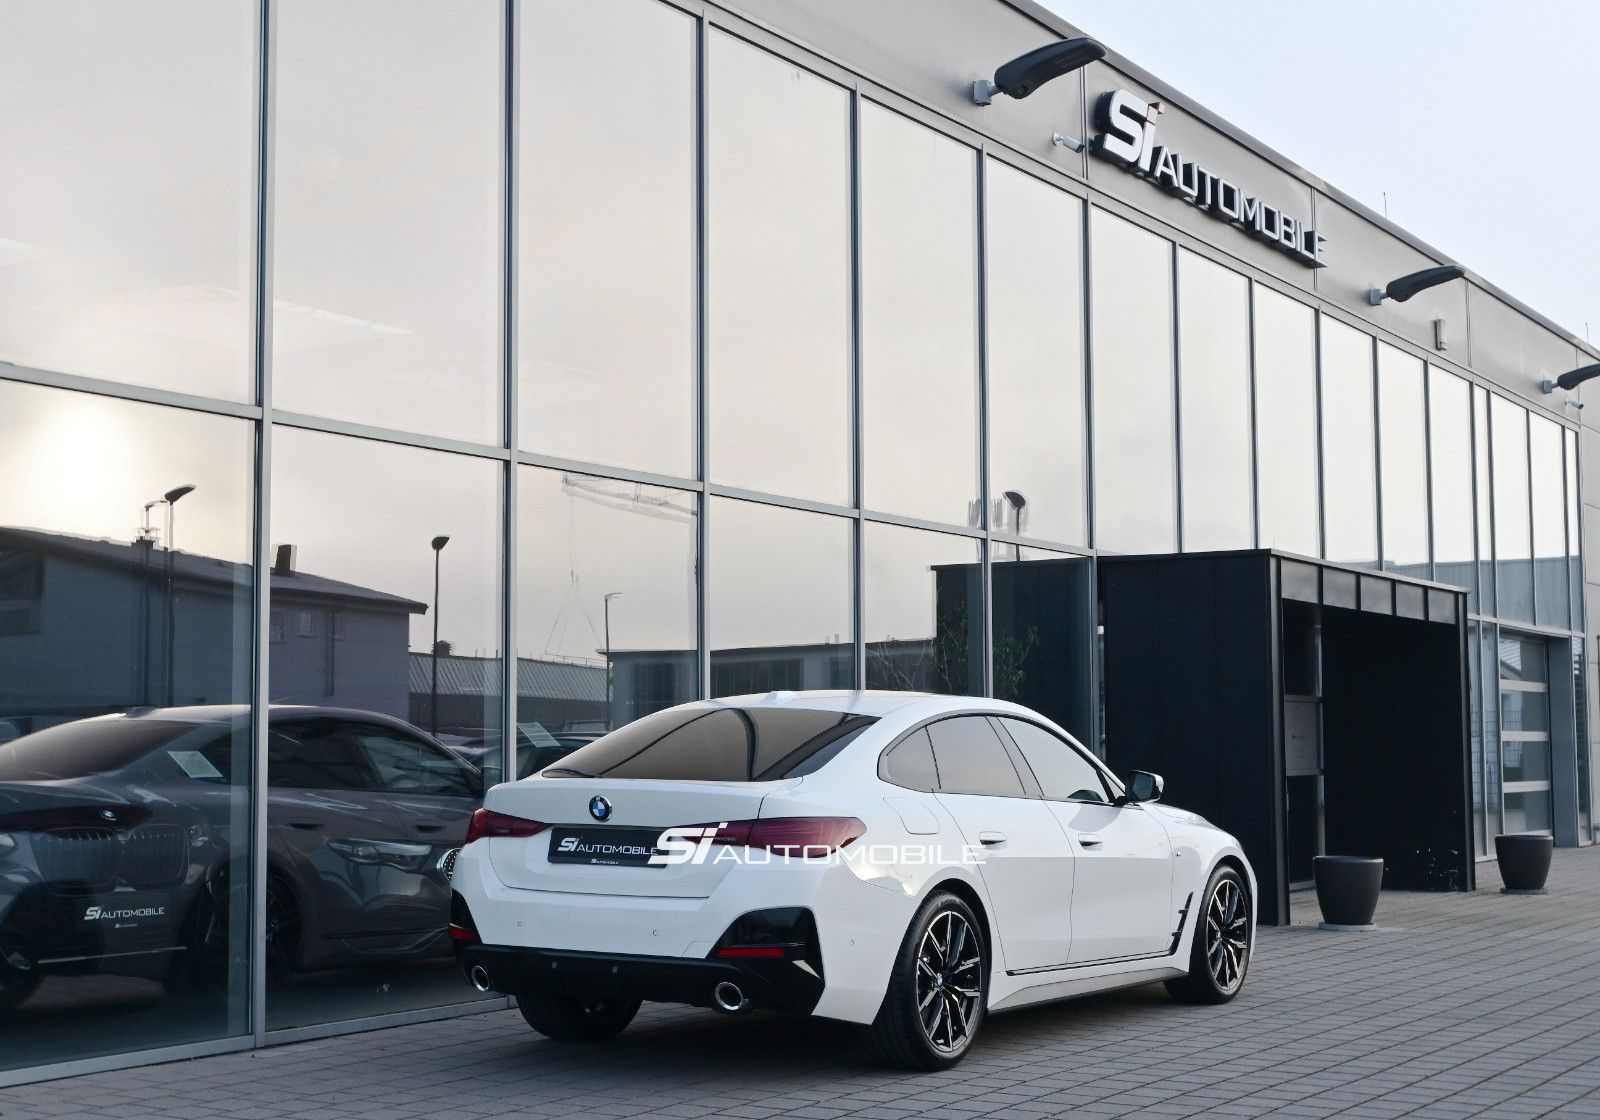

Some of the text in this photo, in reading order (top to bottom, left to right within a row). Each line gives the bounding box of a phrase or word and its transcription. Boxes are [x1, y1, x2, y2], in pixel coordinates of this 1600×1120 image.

[1153, 146, 1328, 268] AUTOMOBILE
[577, 844, 659, 856] AUTOMOBILE
[101, 907, 165, 919] AUTOMOBILE
